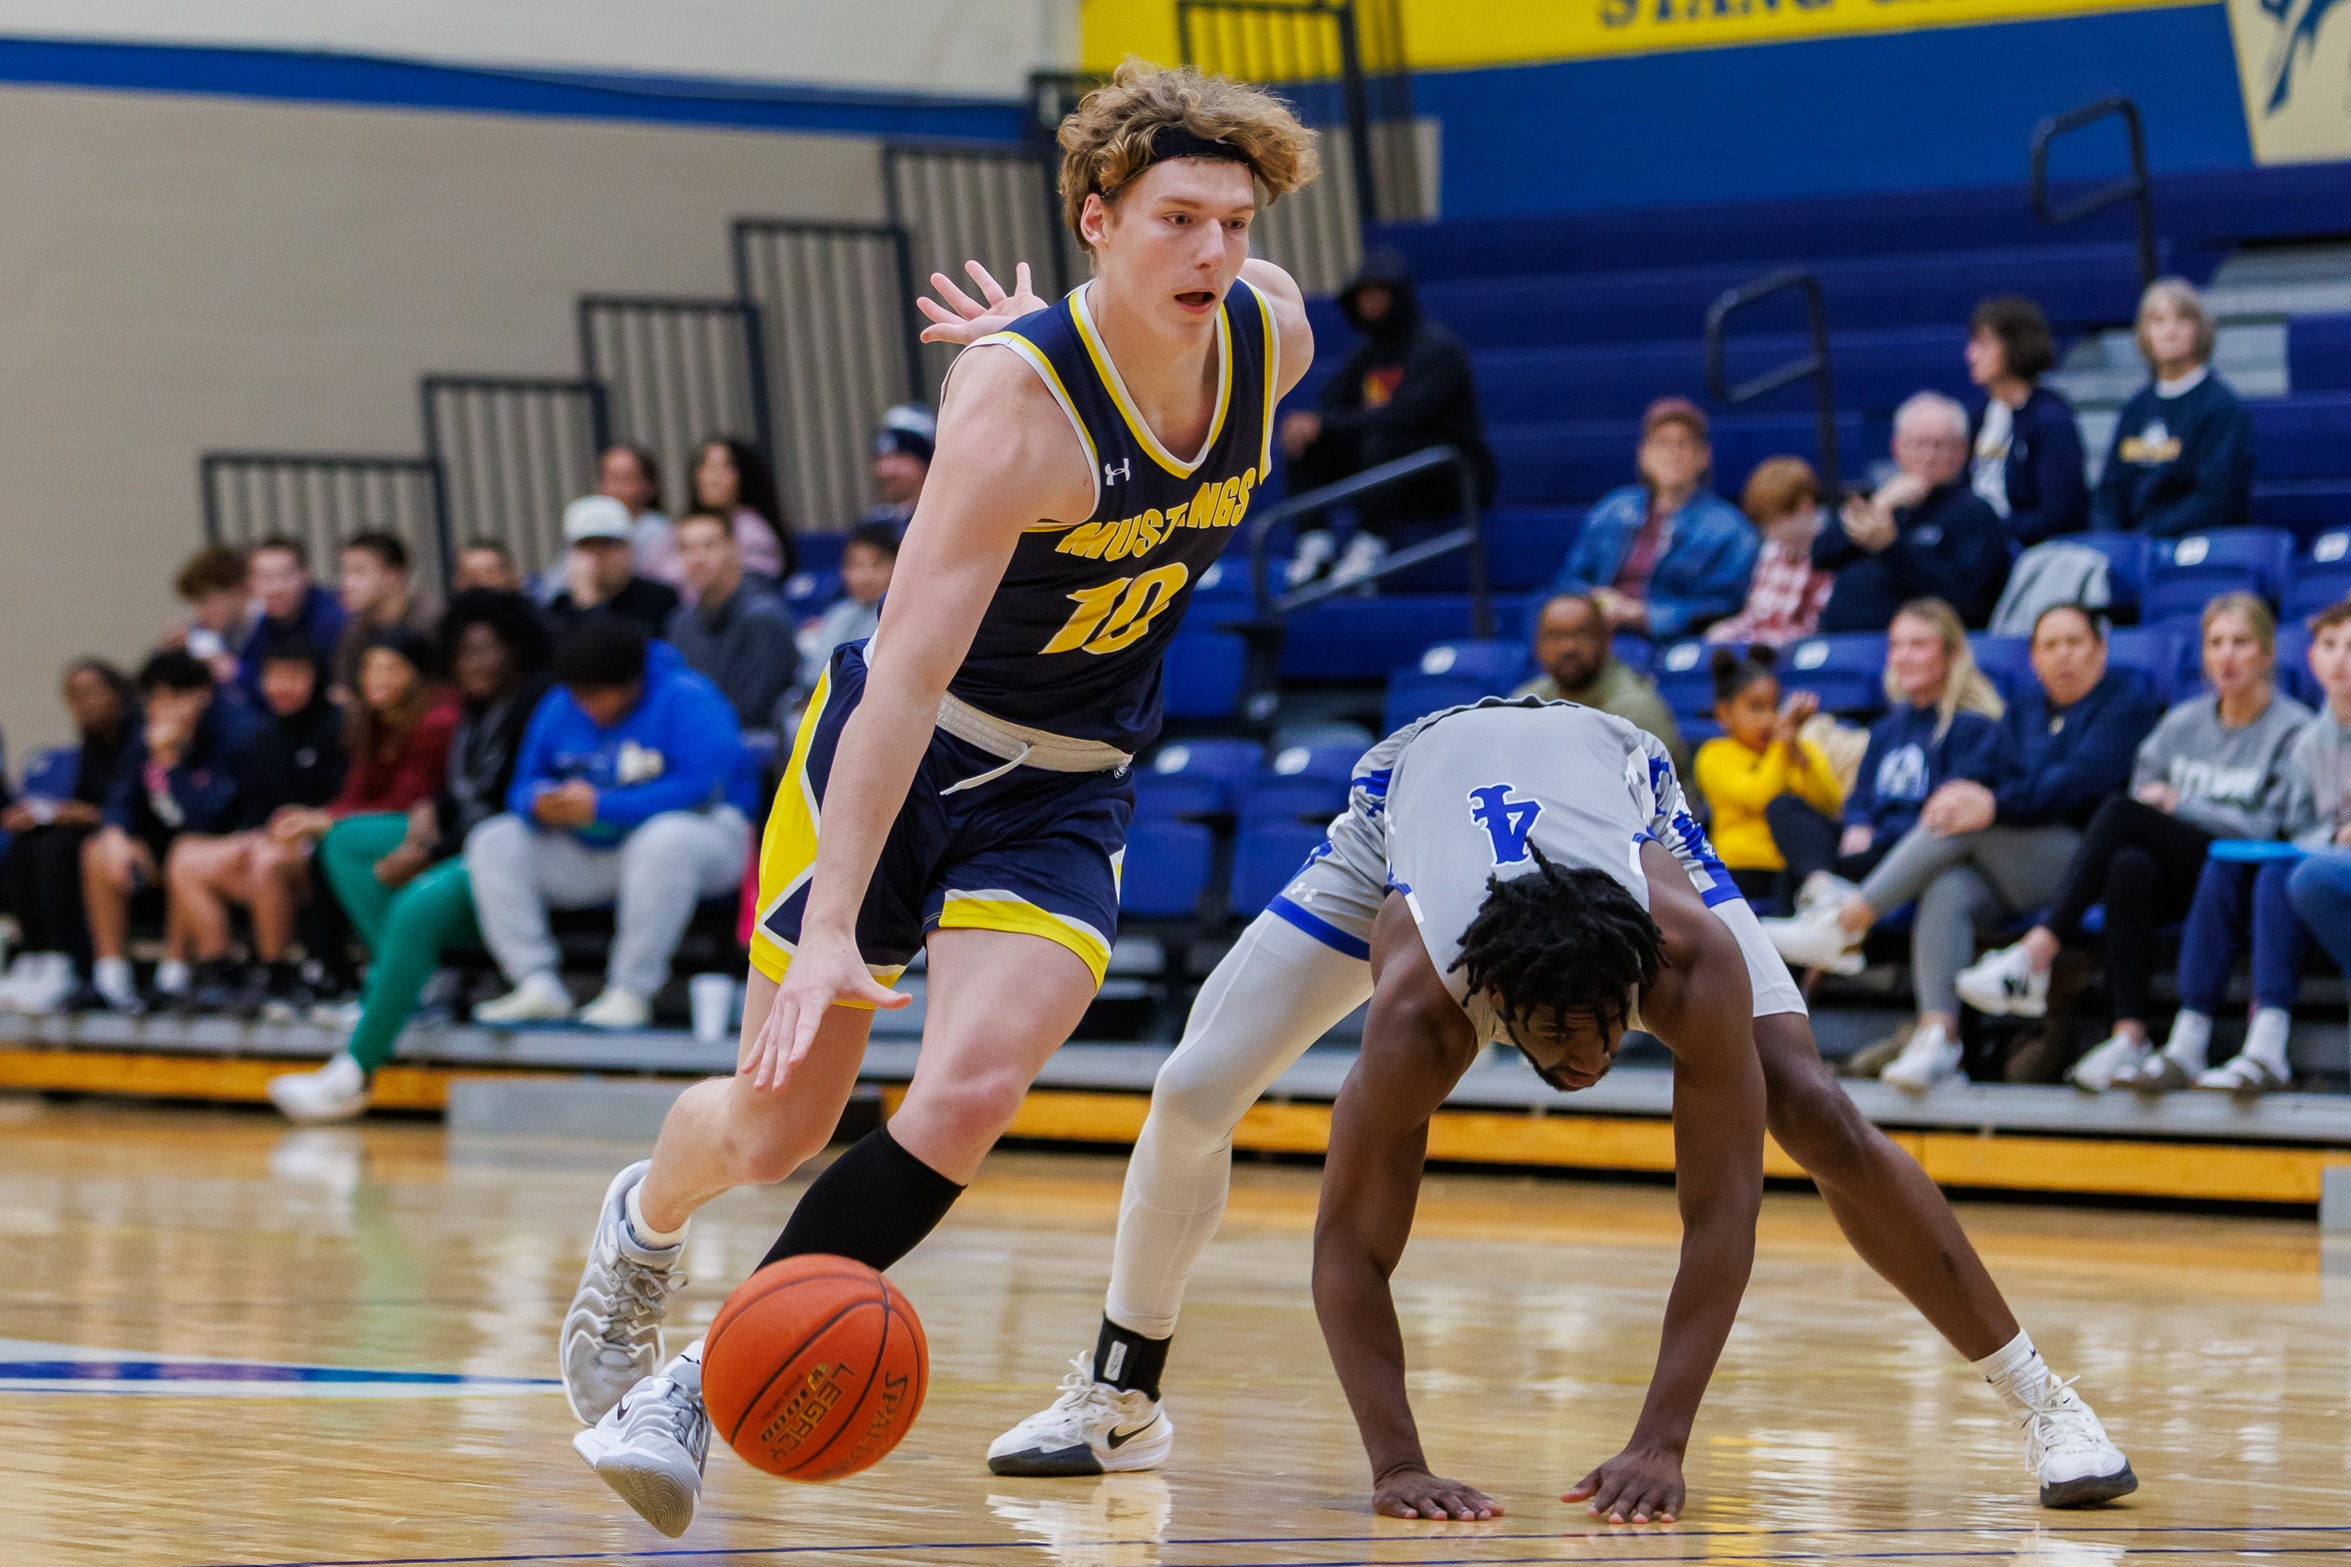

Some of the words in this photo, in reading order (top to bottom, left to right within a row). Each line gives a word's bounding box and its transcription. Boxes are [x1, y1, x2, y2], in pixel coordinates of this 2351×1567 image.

[1037, 562, 1189, 655] 10
[1466, 782, 1547, 868] 4
[768, 1362, 856, 1463] LEGACY
